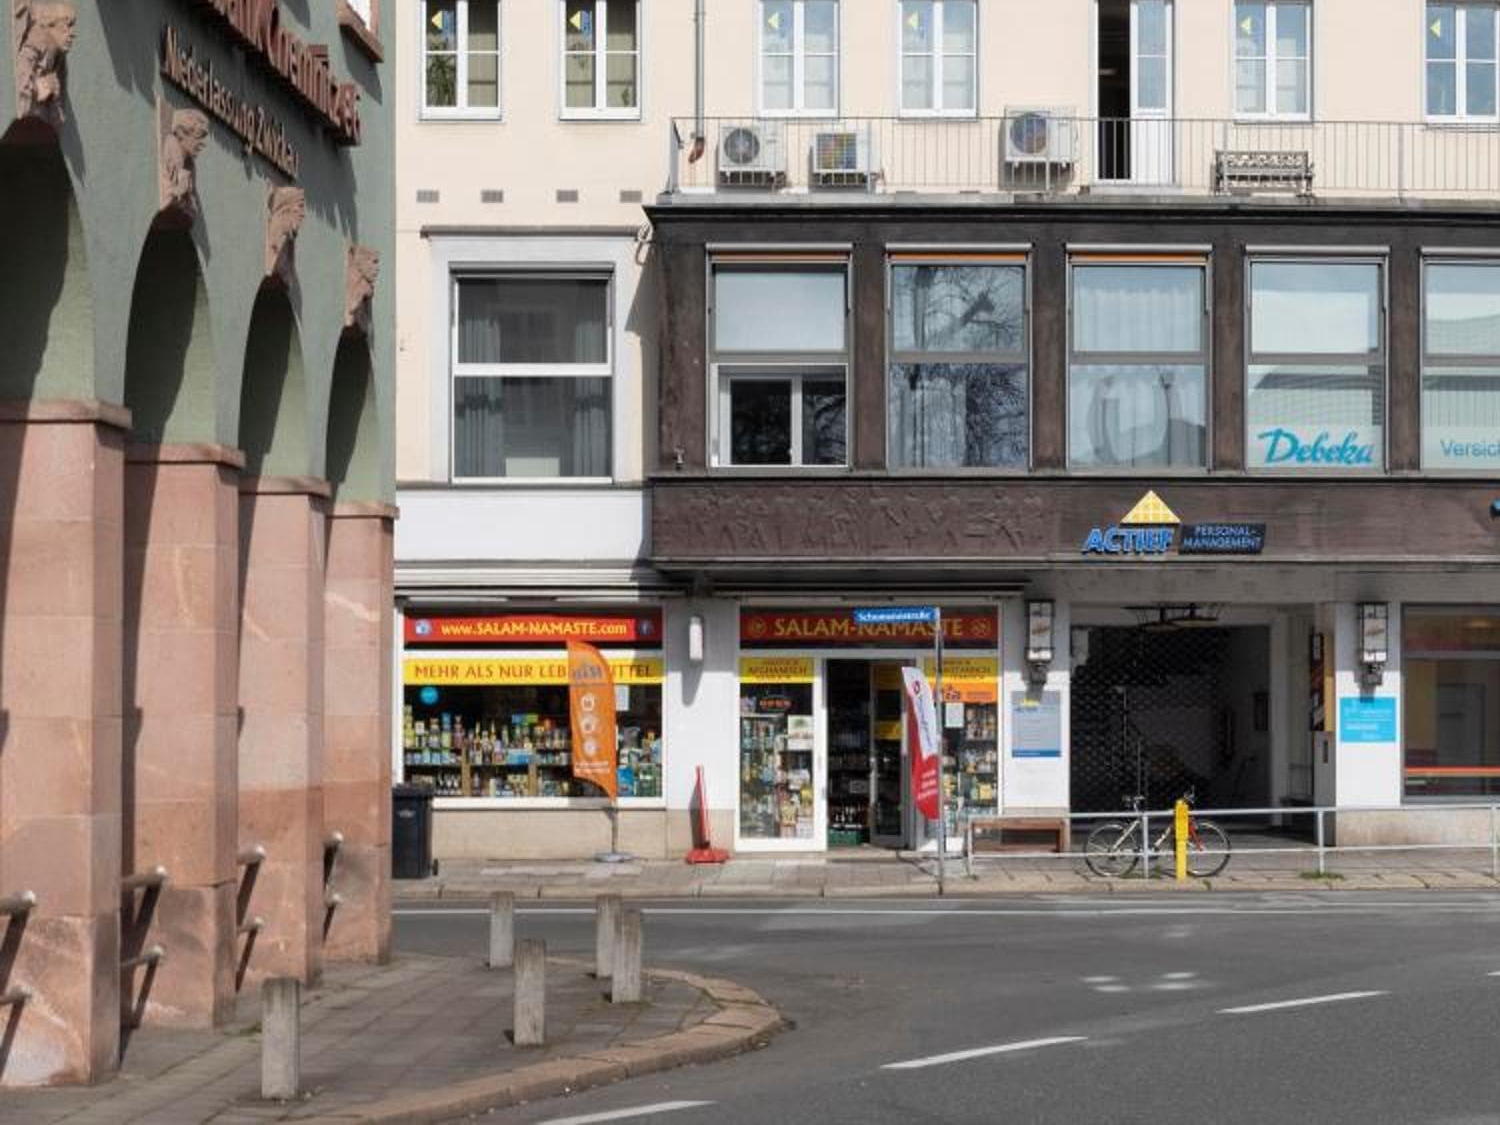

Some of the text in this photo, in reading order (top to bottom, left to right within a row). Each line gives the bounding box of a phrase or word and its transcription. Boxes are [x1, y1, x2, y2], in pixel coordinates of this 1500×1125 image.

[1257, 427, 1375, 465] Debeka
[1194, 525, 1257, 537] PERSONAL-
[1084, 526, 1175, 554] ACTIEF
[1183, 536, 1262, 550] MANAGEMENT
[441, 621, 628, 637] www.SALAM-NAMASTE.com
[414, 665, 461, 678] MEHR
[465, 665, 494, 678] ALS
[499, 665, 534, 678] NUR
[539, 665, 652, 678] LEBTTEL
